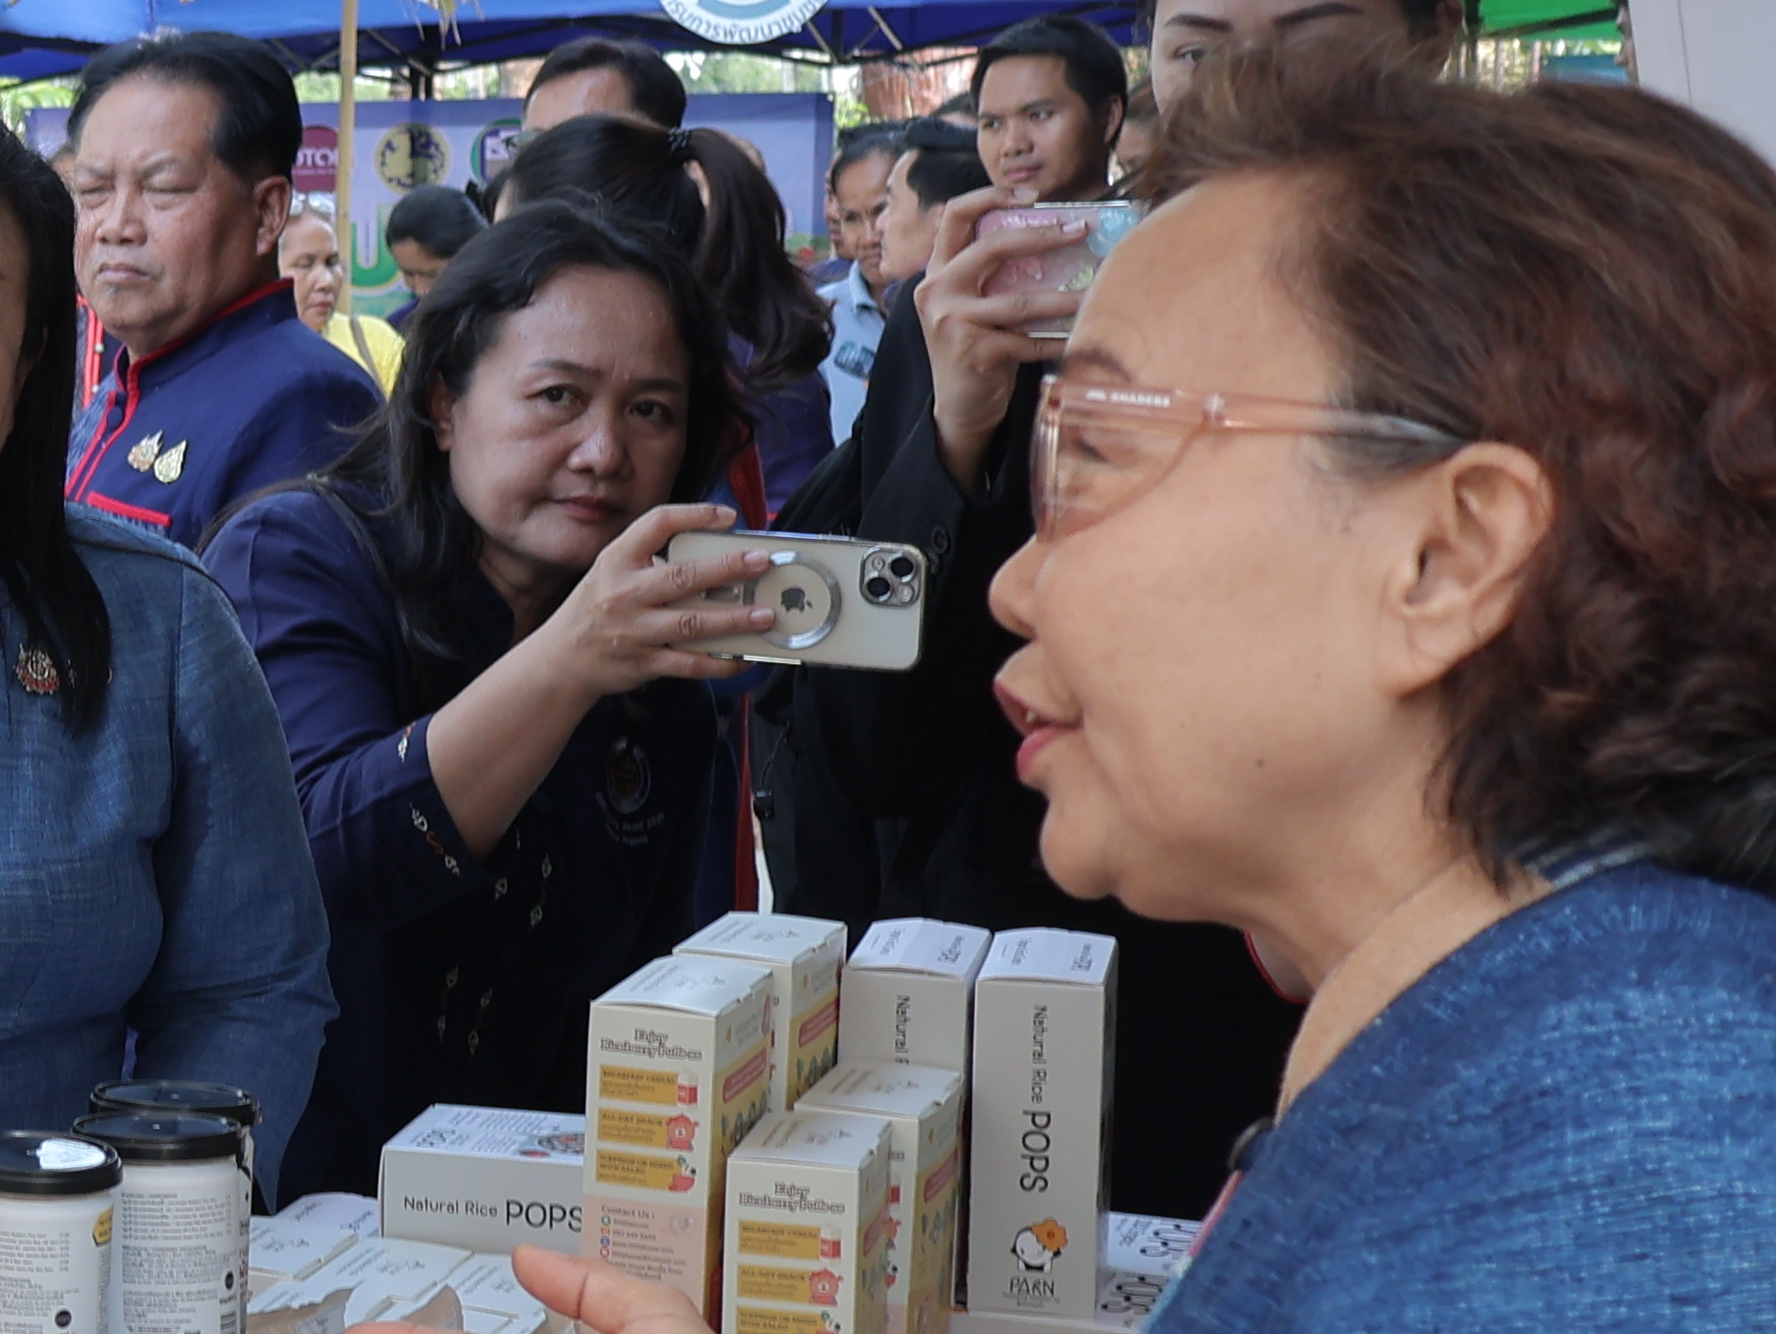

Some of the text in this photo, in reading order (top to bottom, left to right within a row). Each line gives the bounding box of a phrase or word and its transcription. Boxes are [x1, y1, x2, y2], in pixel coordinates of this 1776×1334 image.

[894, 995, 910, 1054] Natural
[1019, 1005, 1052, 1193] Natural Rice POPS
[403, 1195, 583, 1233] Natural Rice POPS
[1009, 1275, 1055, 1297] PARN
